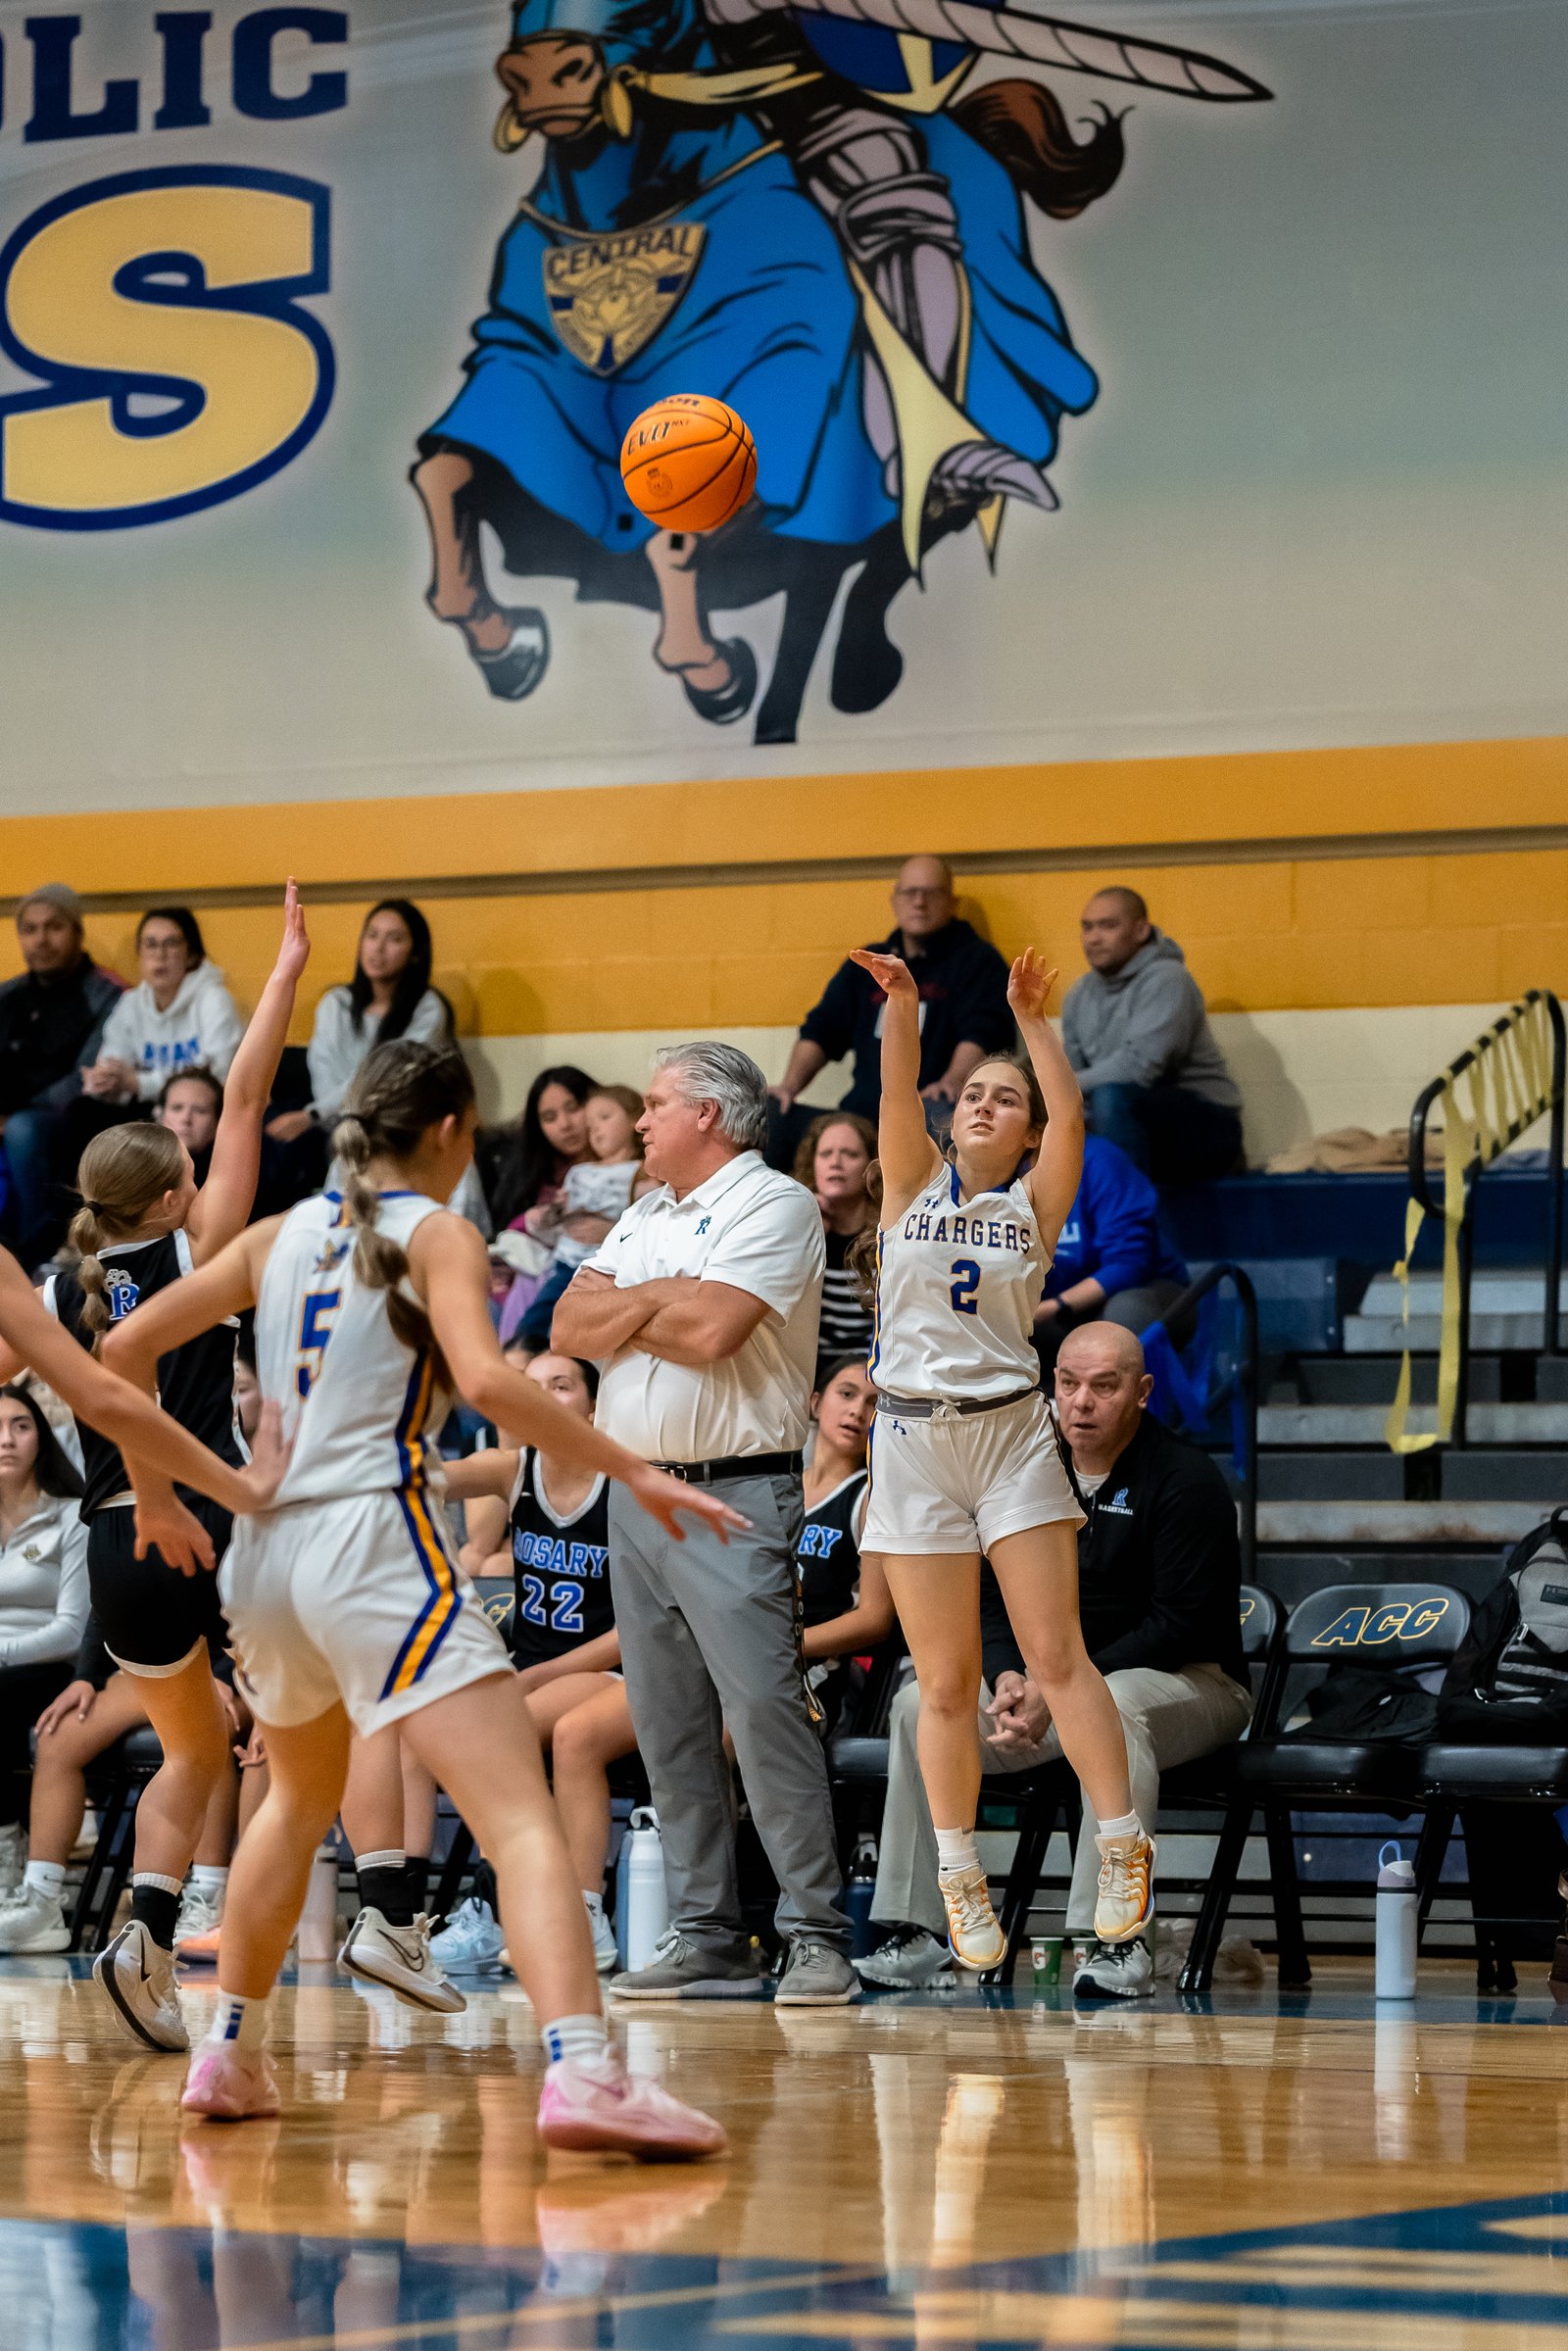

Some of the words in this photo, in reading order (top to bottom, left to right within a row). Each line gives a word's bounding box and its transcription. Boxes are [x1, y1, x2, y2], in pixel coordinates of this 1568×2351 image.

[0, 7, 348, 144] LIC
[548, 227, 694, 283] CENTRAL
[0, 163, 335, 531] S
[904, 1212, 1031, 1254] CHARGERS
[110, 1283, 140, 1320] R
[950, 1258, 981, 1316] 2
[296, 1286, 344, 1401] 5
[521, 1573, 584, 1634] 22
[1310, 1597, 1450, 1646] ACC
